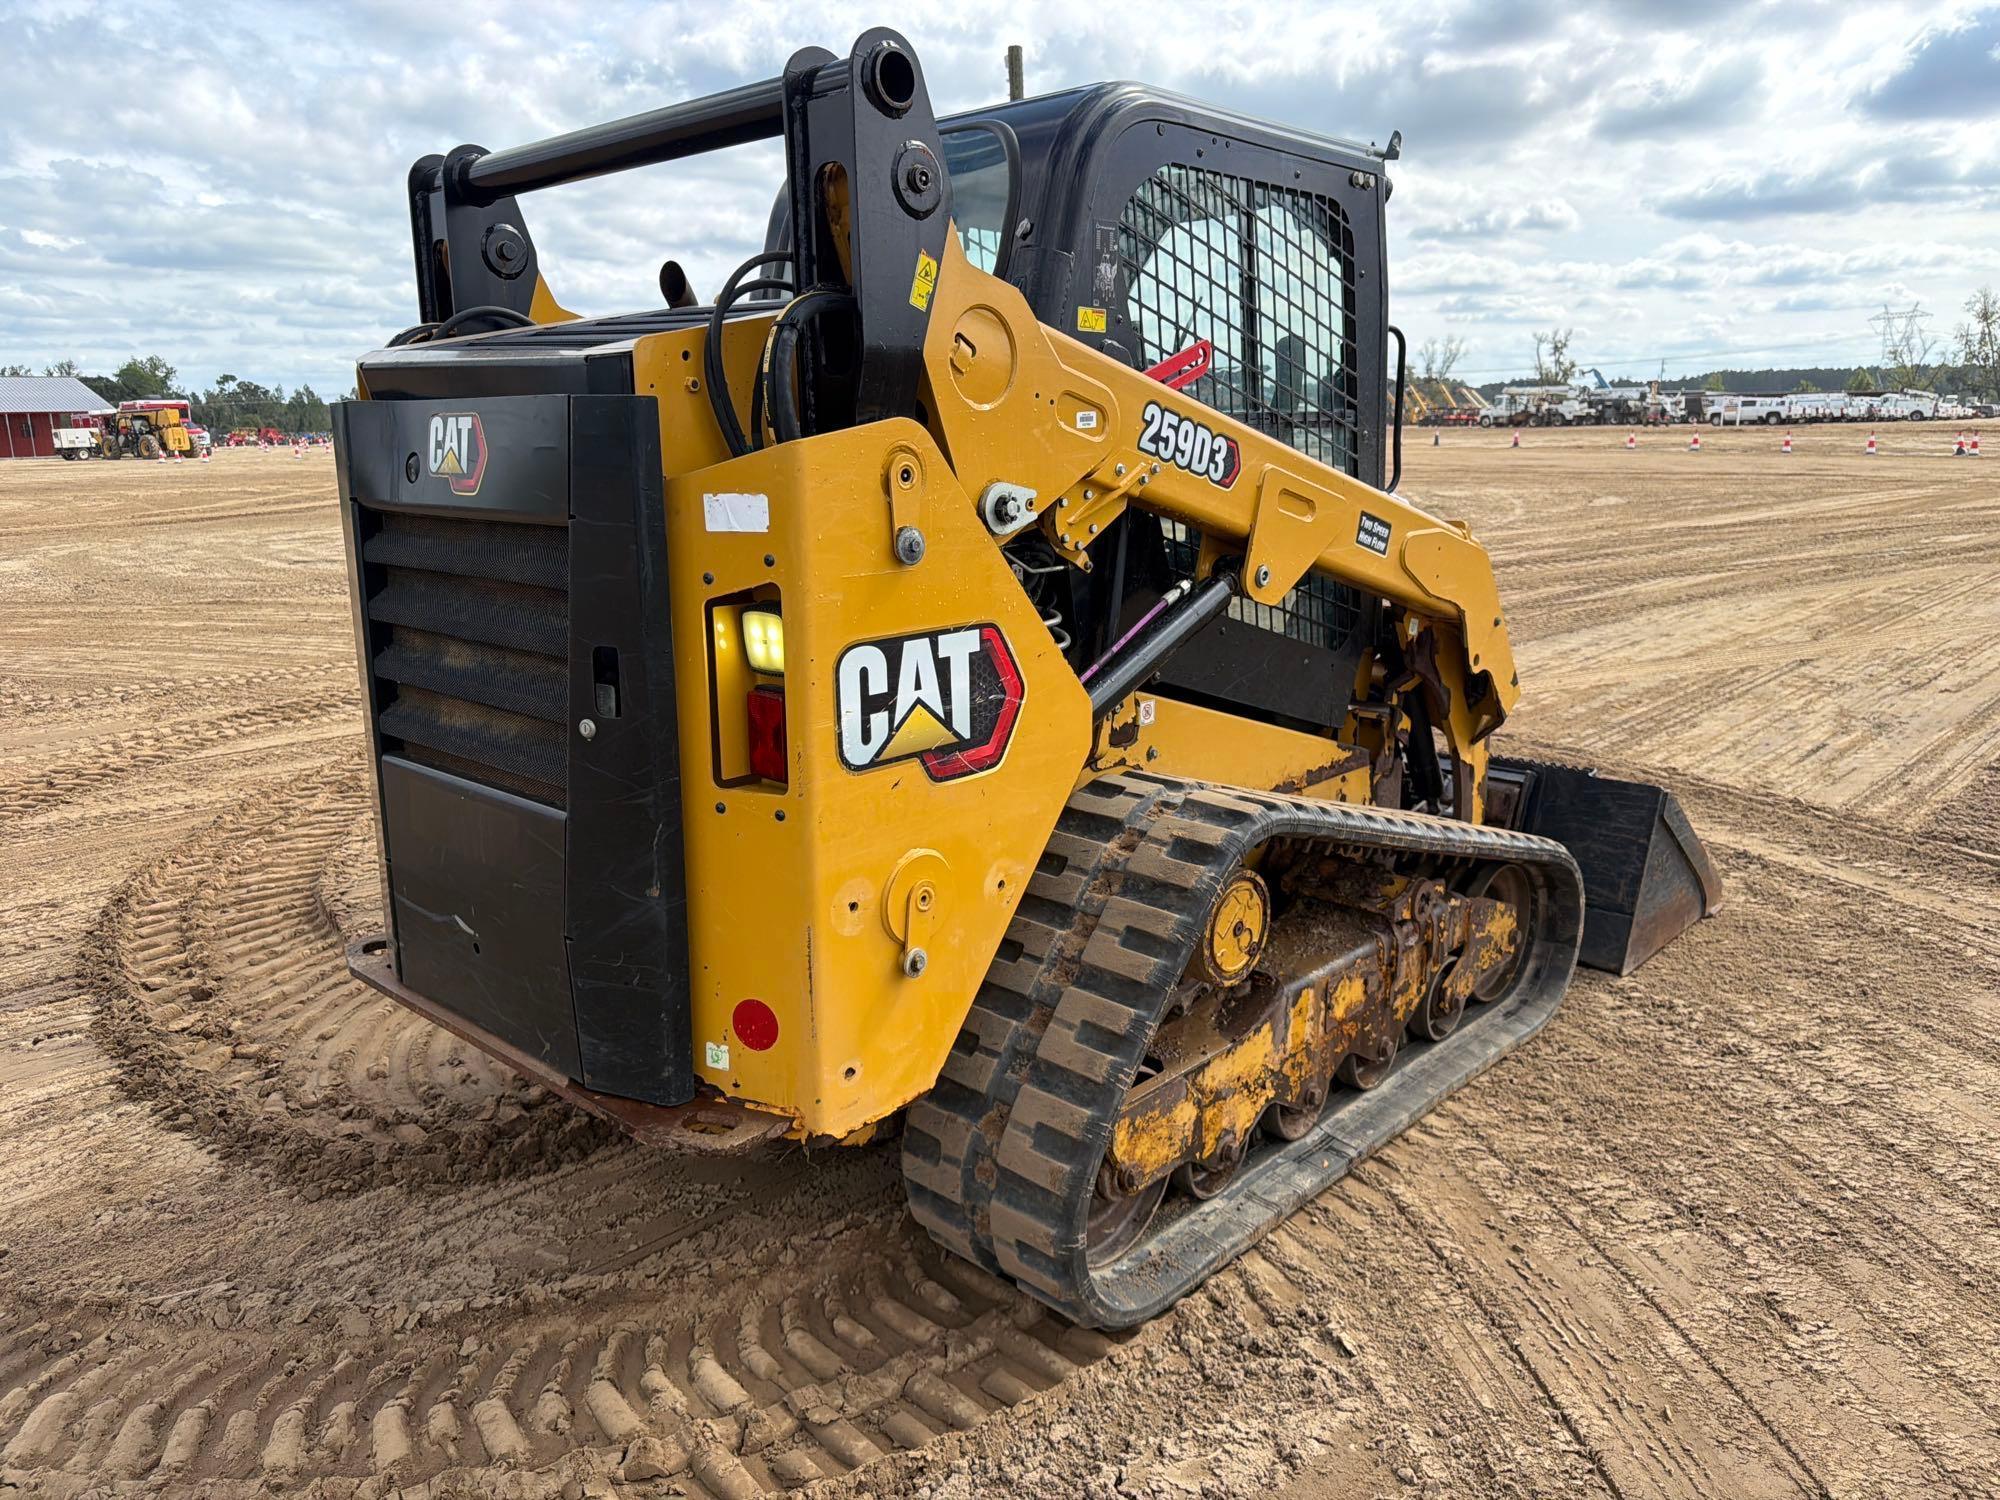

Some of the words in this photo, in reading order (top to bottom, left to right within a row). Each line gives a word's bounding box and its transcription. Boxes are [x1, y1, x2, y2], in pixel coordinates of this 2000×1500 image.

[429, 416, 473, 474] CAT
[1139, 402, 1229, 483] 259D3
[839, 628, 981, 766] CAT
